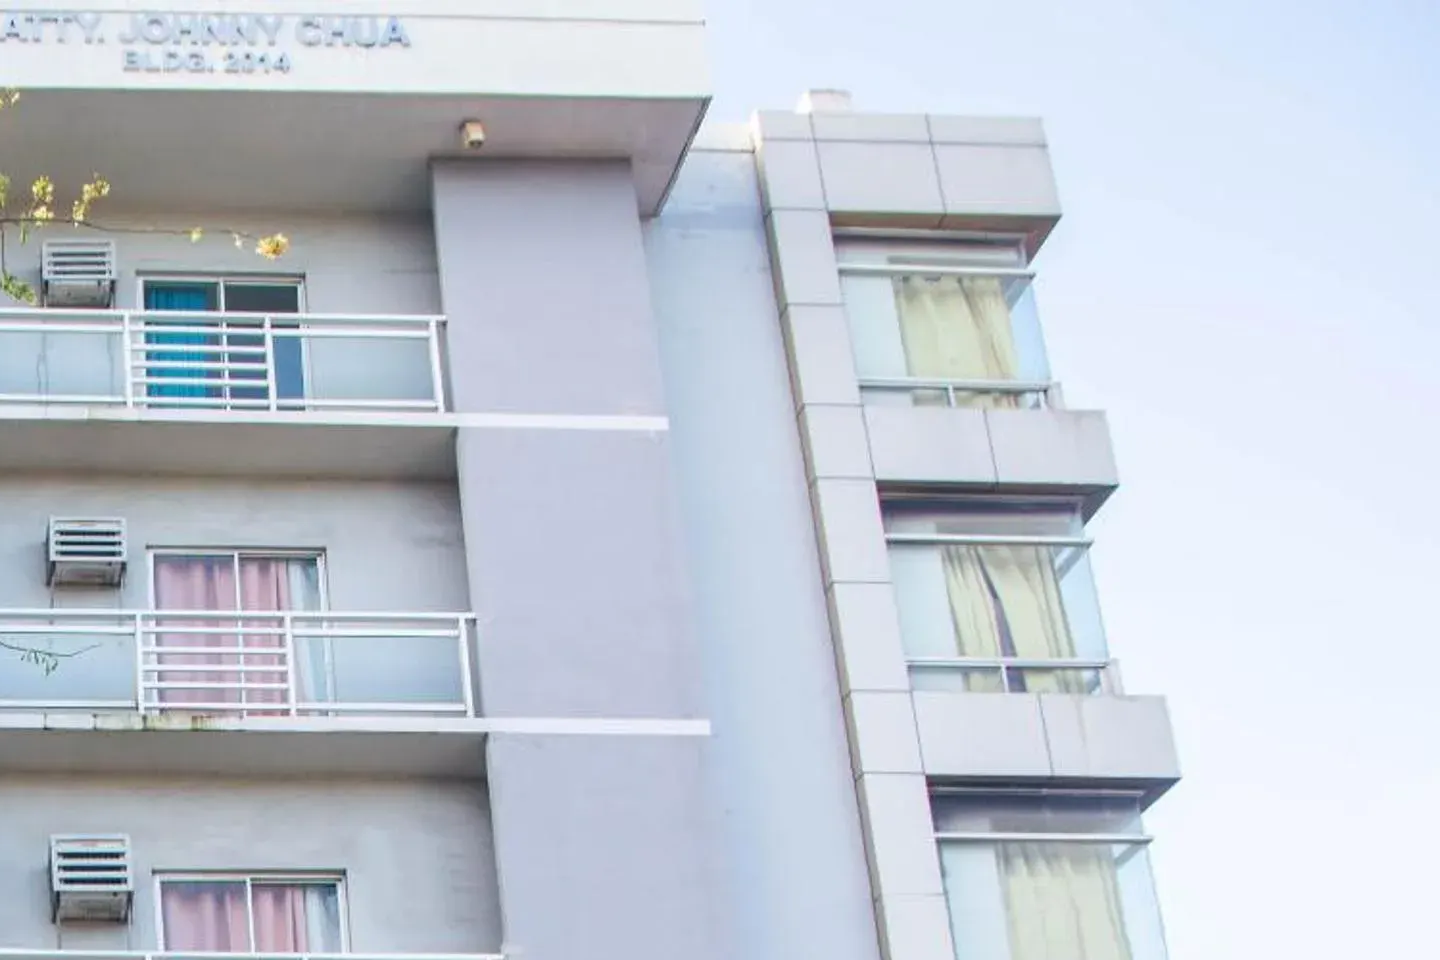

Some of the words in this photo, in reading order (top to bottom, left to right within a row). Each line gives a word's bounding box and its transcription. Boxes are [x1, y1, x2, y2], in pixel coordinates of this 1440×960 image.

[118, 13, 284, 46] JOHNNY
[295, 15, 412, 48] CHUA
[123, 51, 214, 73] BLDG.
